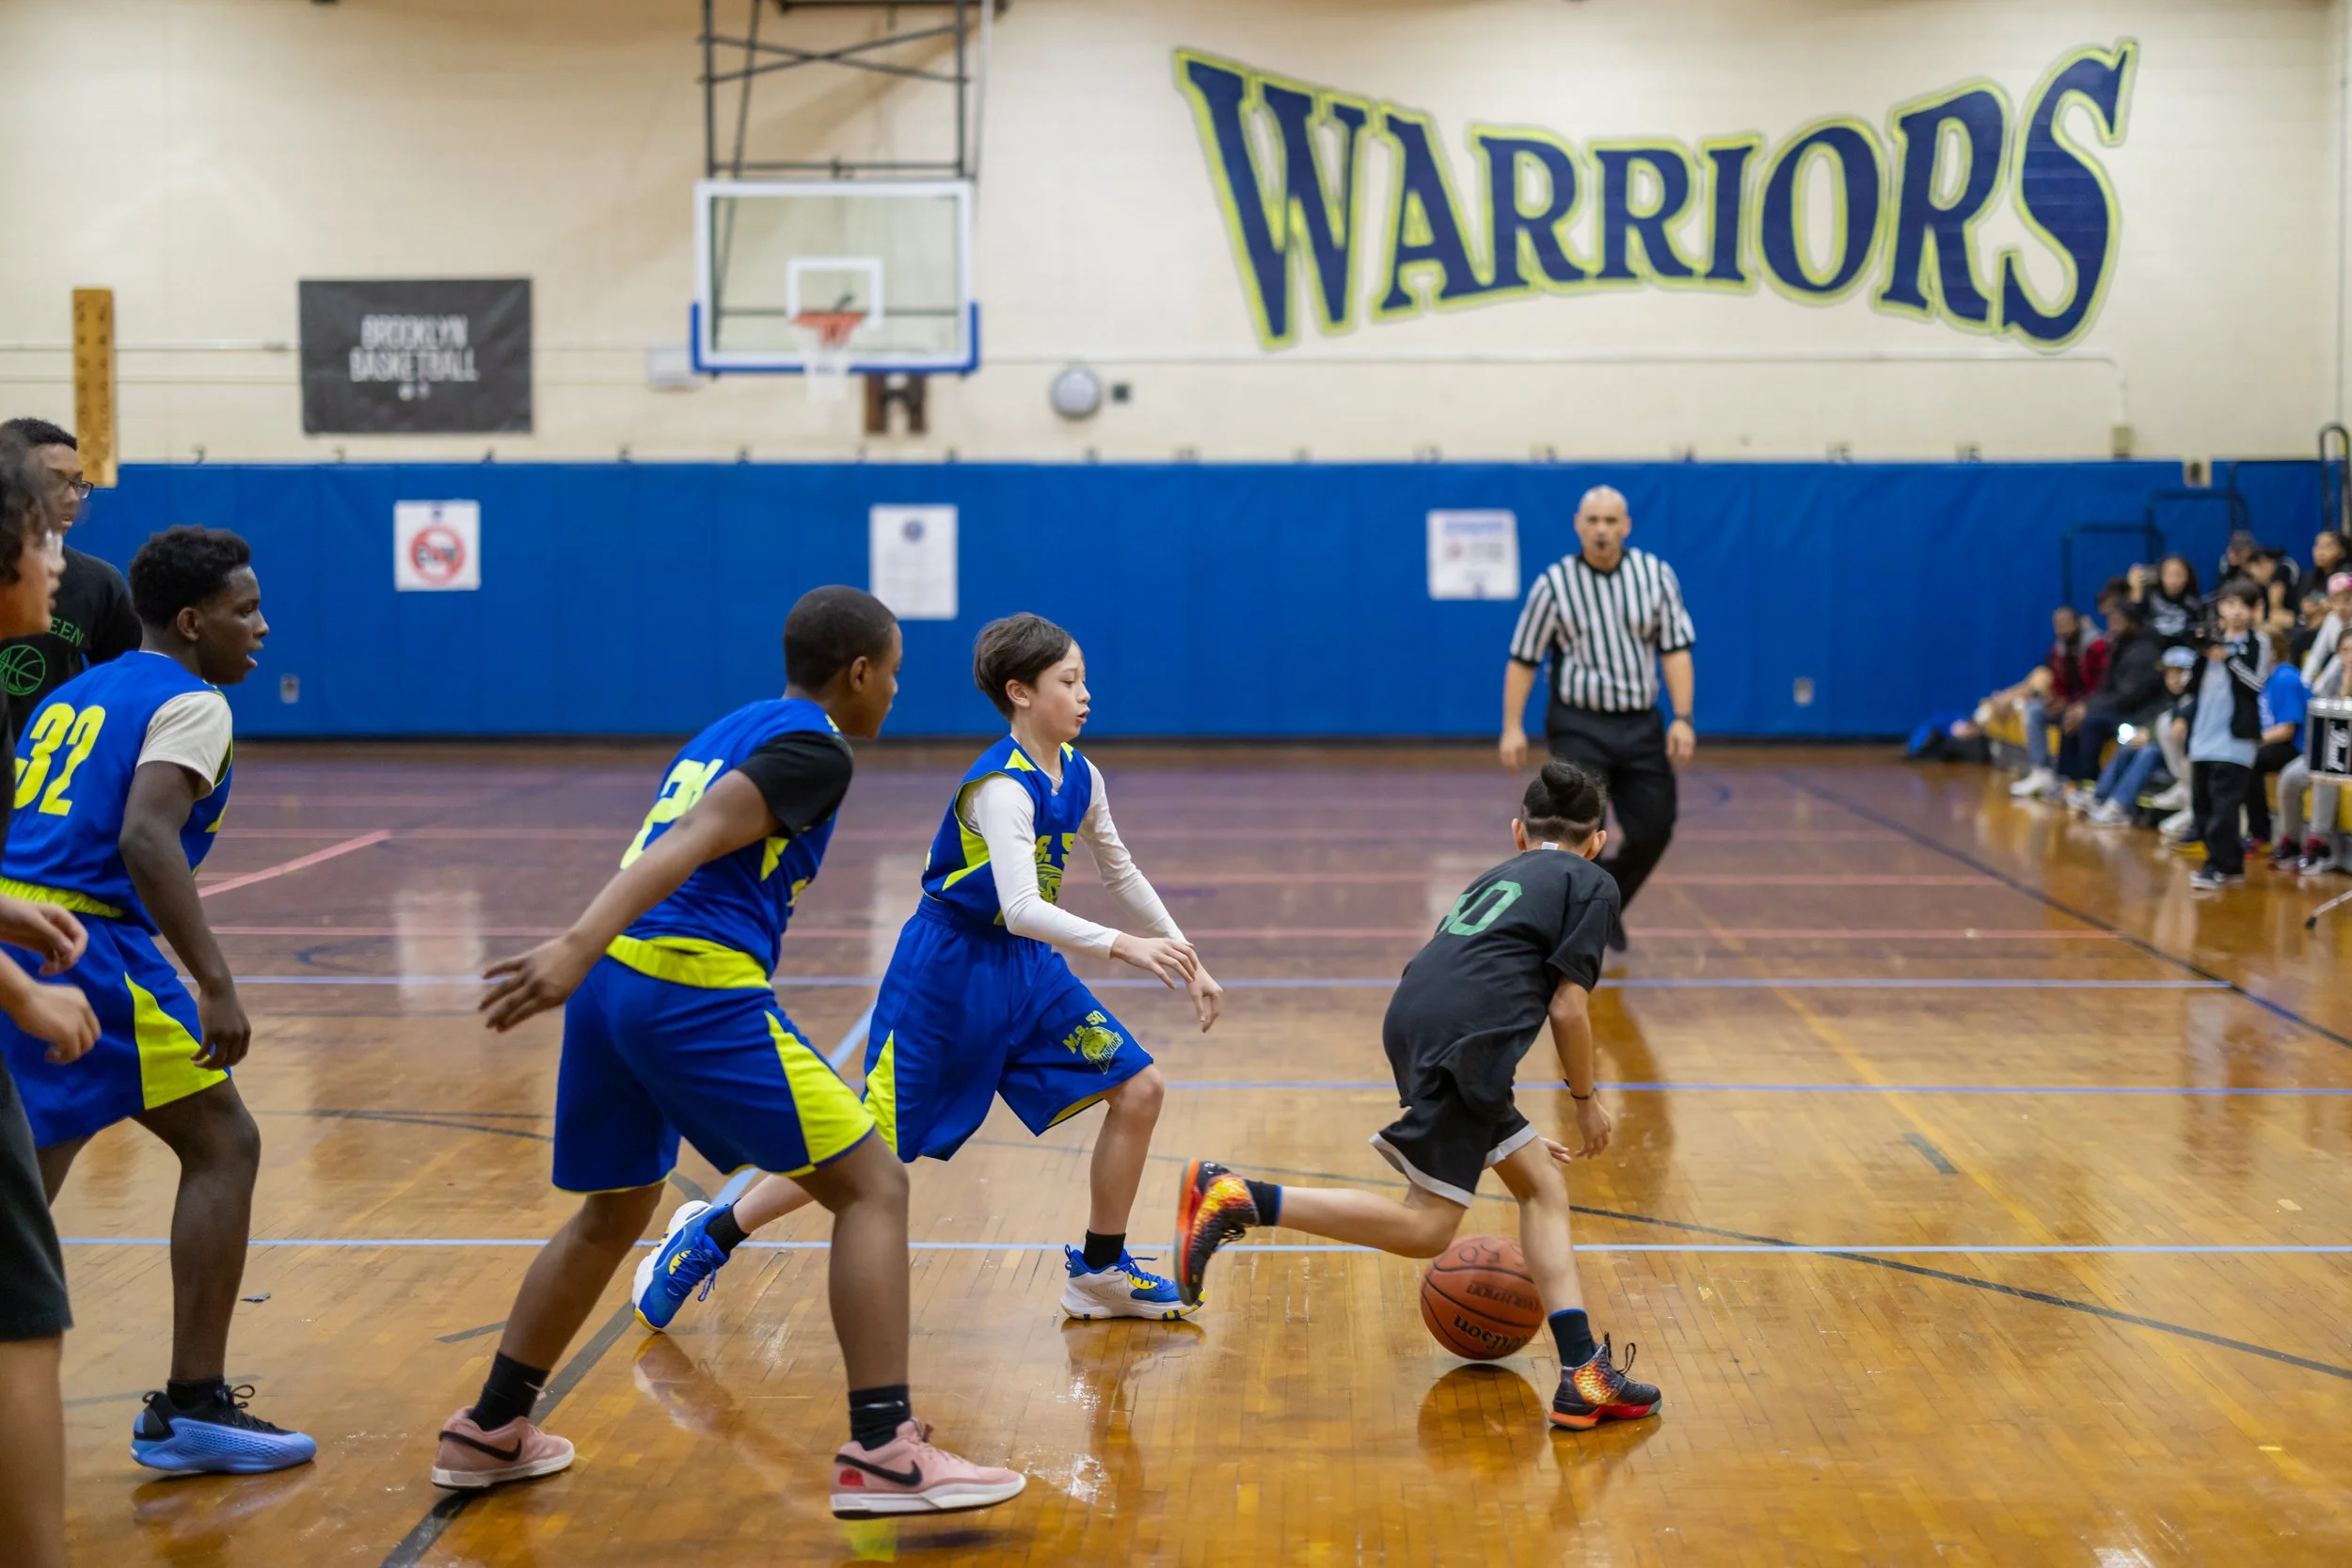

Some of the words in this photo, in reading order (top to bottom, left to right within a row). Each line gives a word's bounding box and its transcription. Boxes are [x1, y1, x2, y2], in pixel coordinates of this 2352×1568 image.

[1176, 40, 2136, 350] WARRIORS
[361, 314, 469, 350] BROOKLYN
[349, 347, 480, 382] BASKETBALL
[13, 703, 106, 816] 32
[1085, 1009, 1107, 1025] 50
